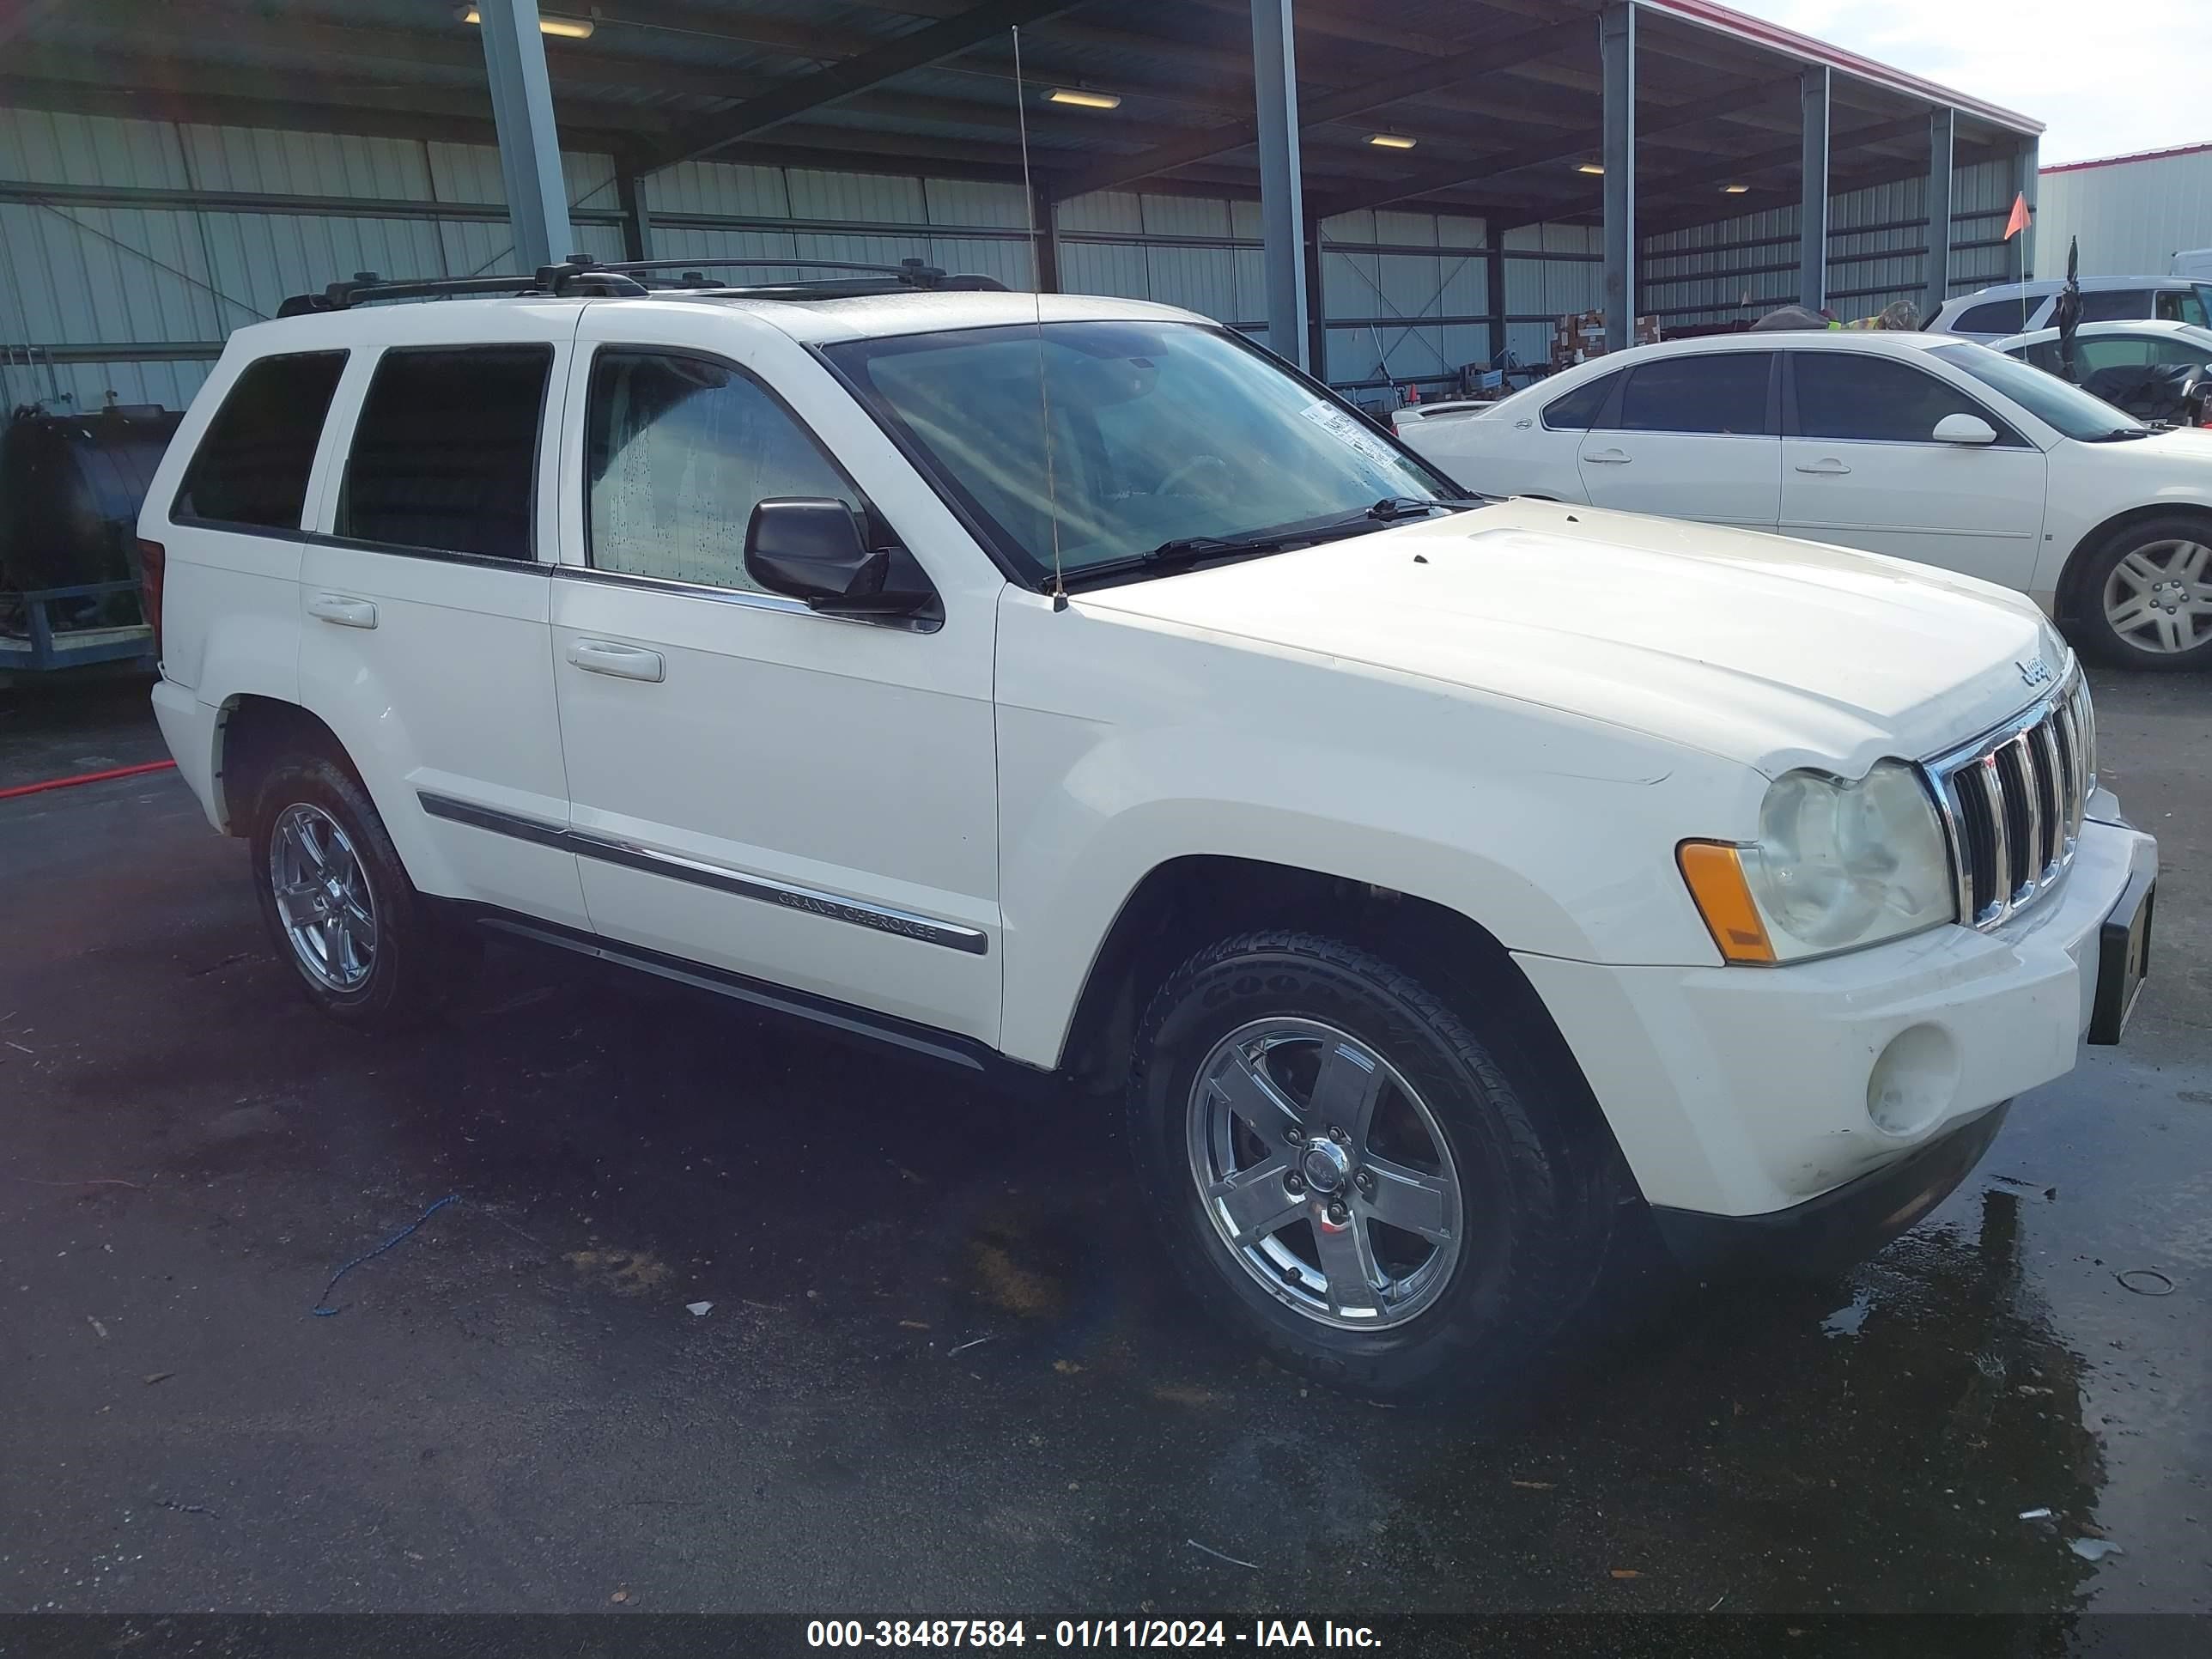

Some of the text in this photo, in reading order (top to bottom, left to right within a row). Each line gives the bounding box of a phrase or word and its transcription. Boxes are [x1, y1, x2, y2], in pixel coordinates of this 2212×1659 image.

[2014, 658, 2052, 688] Jeep
[778, 891, 938, 941] GRAND CHEROKEE
